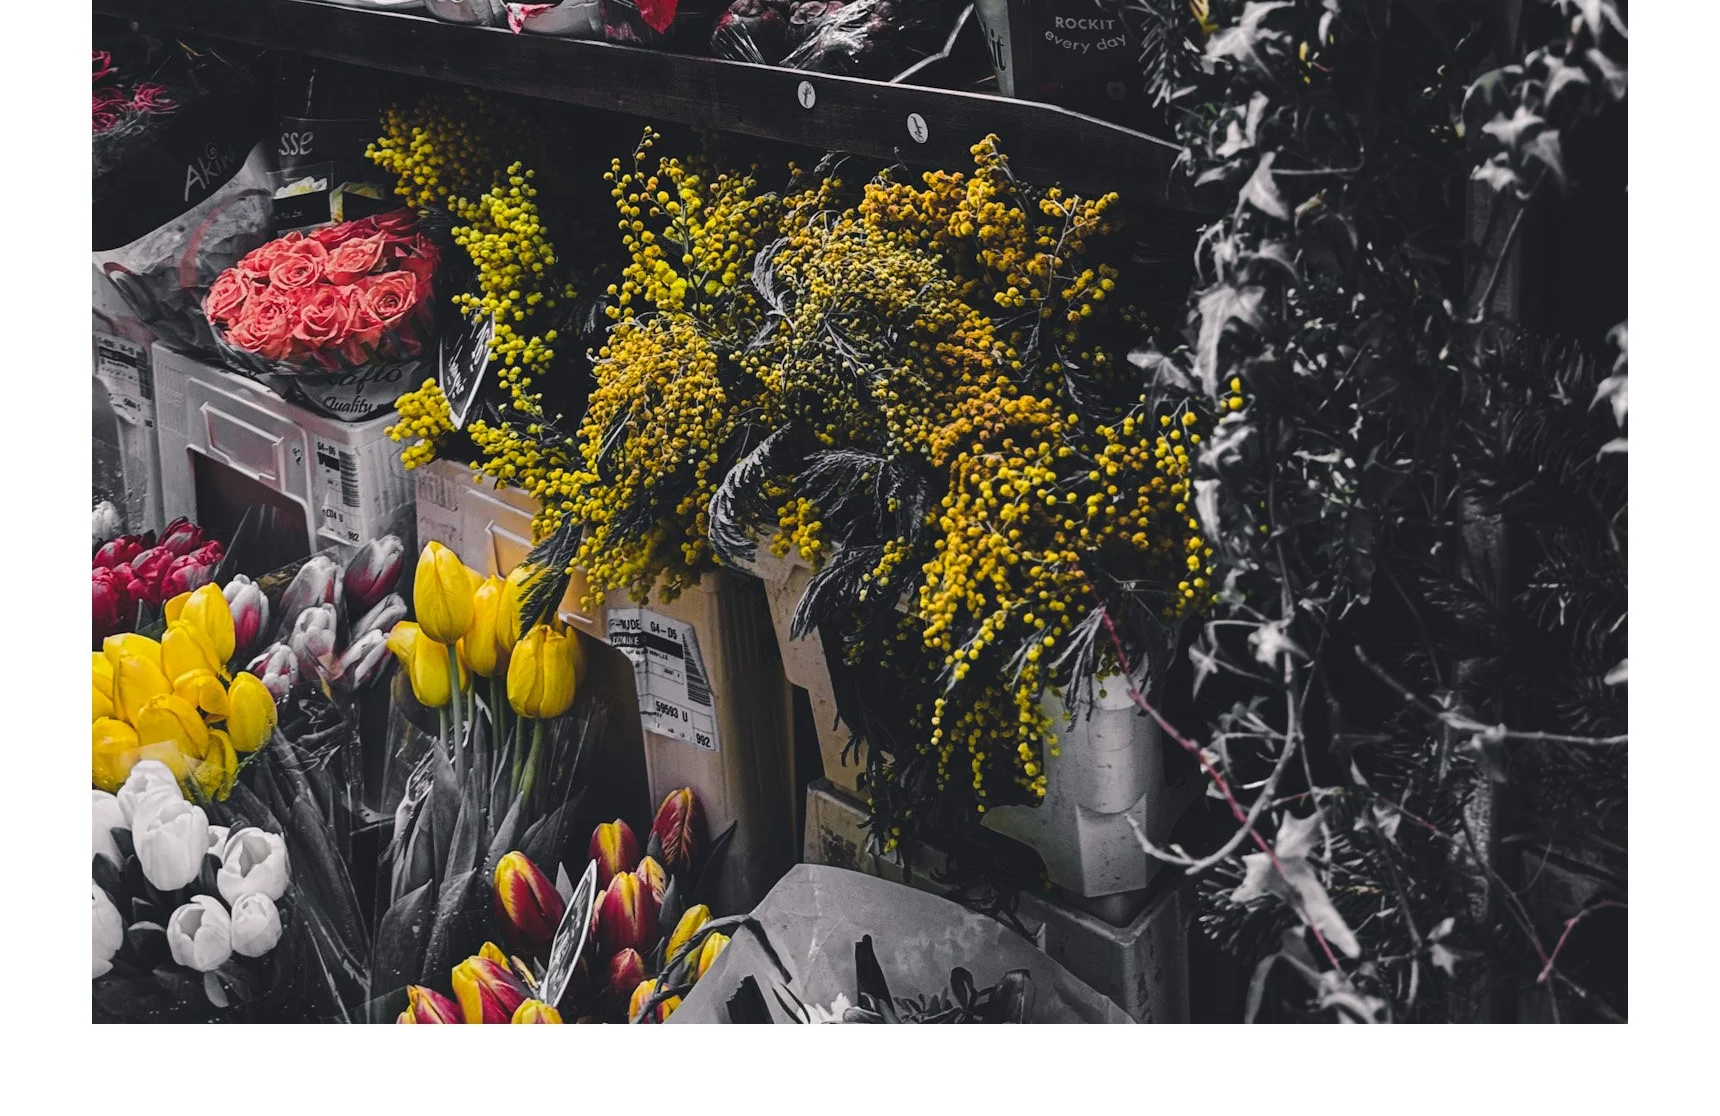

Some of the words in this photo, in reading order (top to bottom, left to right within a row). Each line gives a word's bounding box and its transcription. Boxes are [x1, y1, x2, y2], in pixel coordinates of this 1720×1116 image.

[1055, 16, 1116, 31] ROCKIT
[1045, 30, 1090, 55] every
[1096, 34, 1127, 52] day
[323, 394, 373, 413] Quality
[682, 710, 688, 723] U
[696, 732, 711, 748] 992
